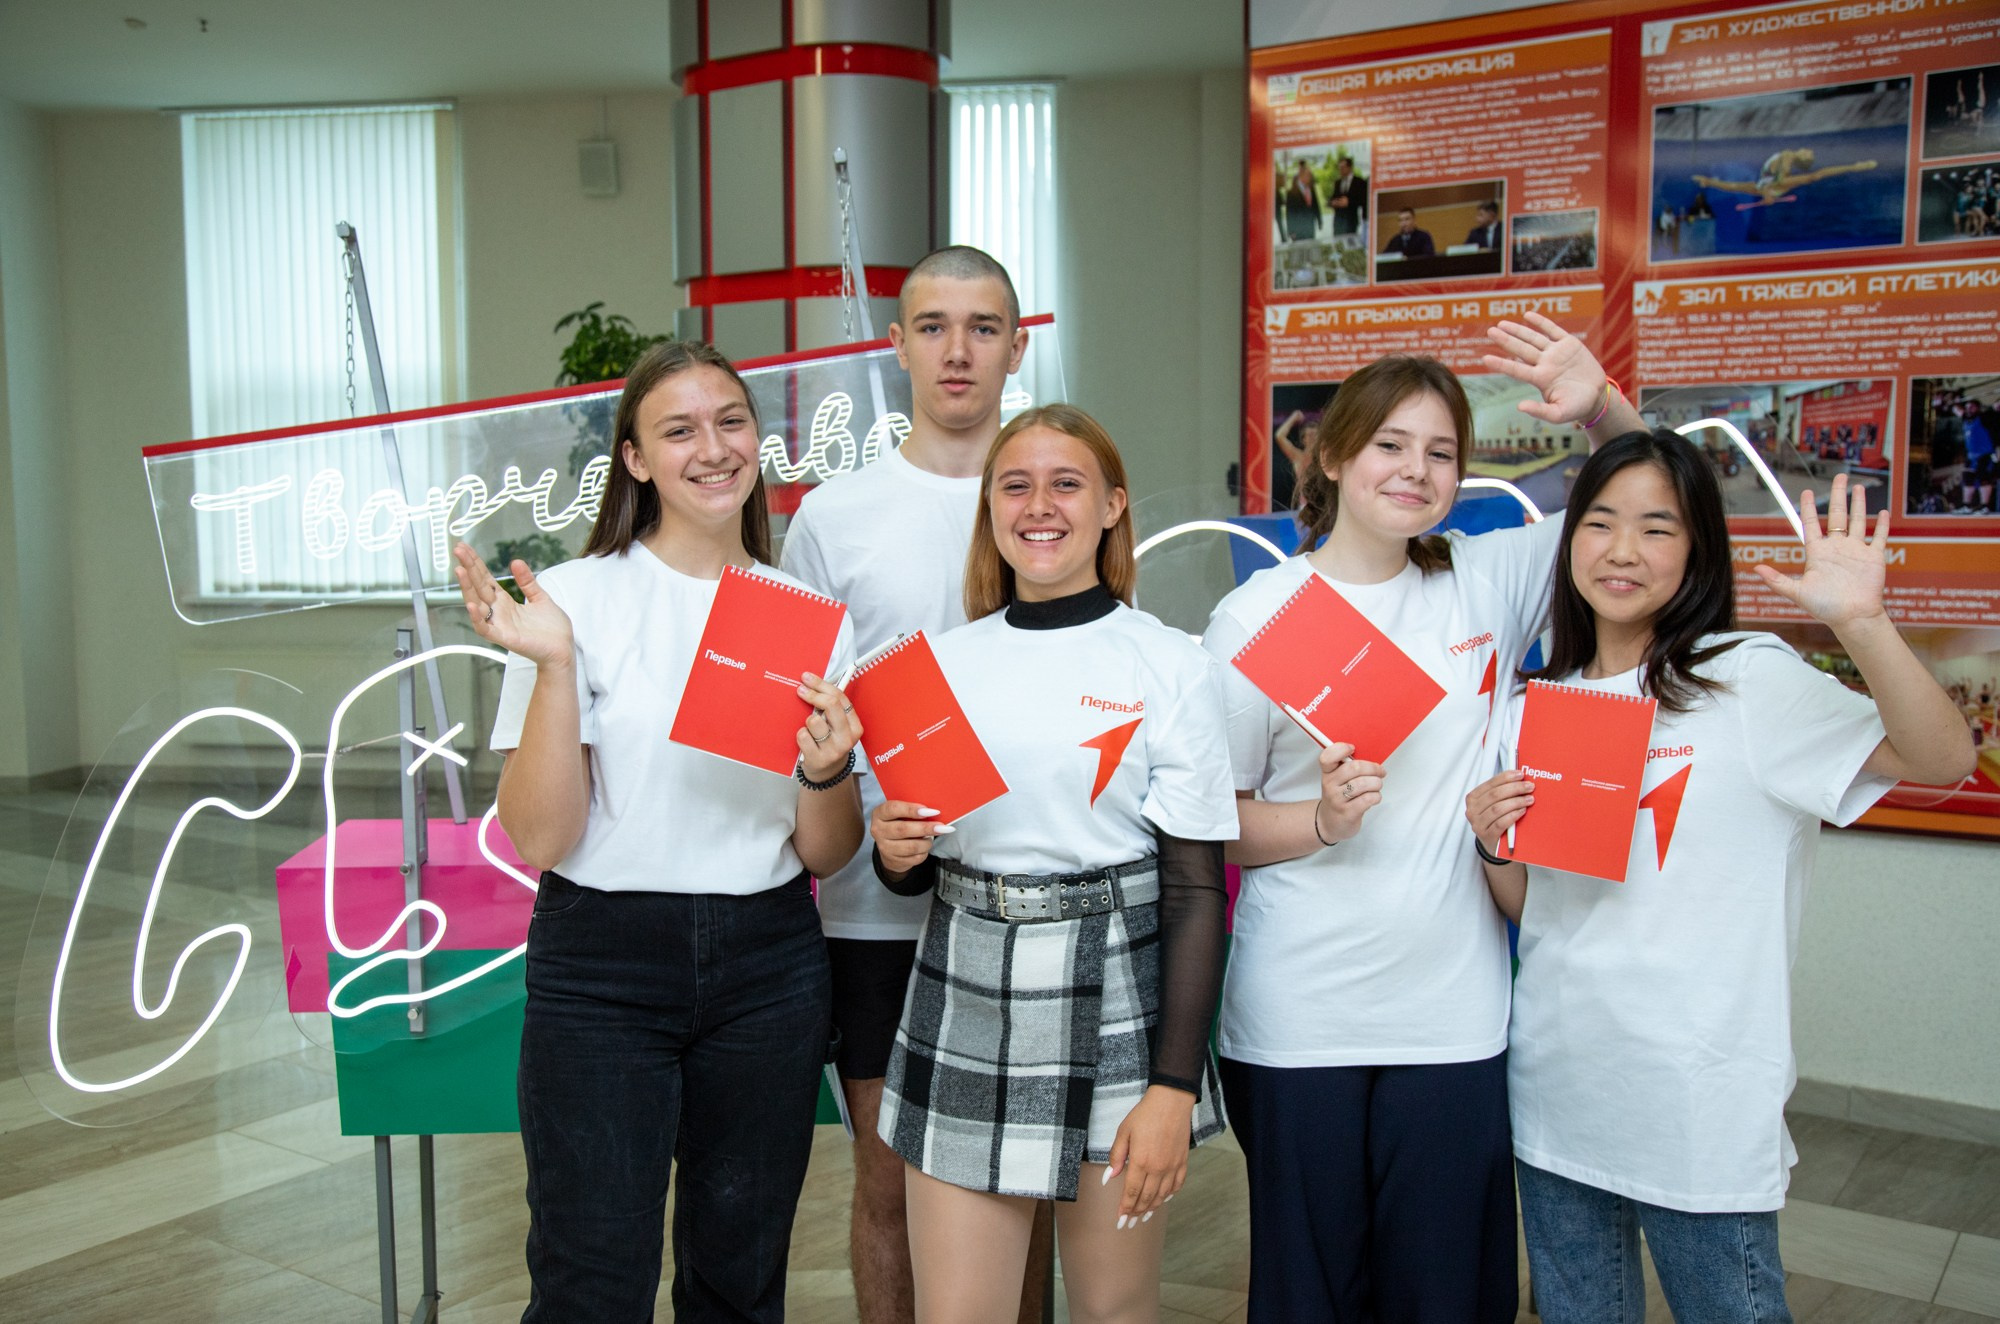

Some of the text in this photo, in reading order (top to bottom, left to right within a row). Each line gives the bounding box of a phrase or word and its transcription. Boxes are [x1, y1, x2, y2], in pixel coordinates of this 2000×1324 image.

[1680, 25, 1718, 43] ЗАЛ
[1301, 73, 1367, 96] ОБЩАЯ
[1374, 53, 1515, 87] ИНФОРМАЦИЯ
[1679, 287, 1726, 305] ЗАЛ
[1737, 275, 1856, 302] ТЯЖЕЛОЙ
[1301, 296, 1572, 327] ЗАЛ ПРЫЖКОВ НА БАТУТЕ
[1449, 632, 1494, 656] Первые
[705, 649, 747, 670] Первые
[1080, 695, 1144, 713] Первые
[1299, 685, 1332, 718] Первые
[874, 743, 904, 765] Первые
[1647, 745, 1694, 763] рвые
[1521, 765, 1562, 781] Первые
